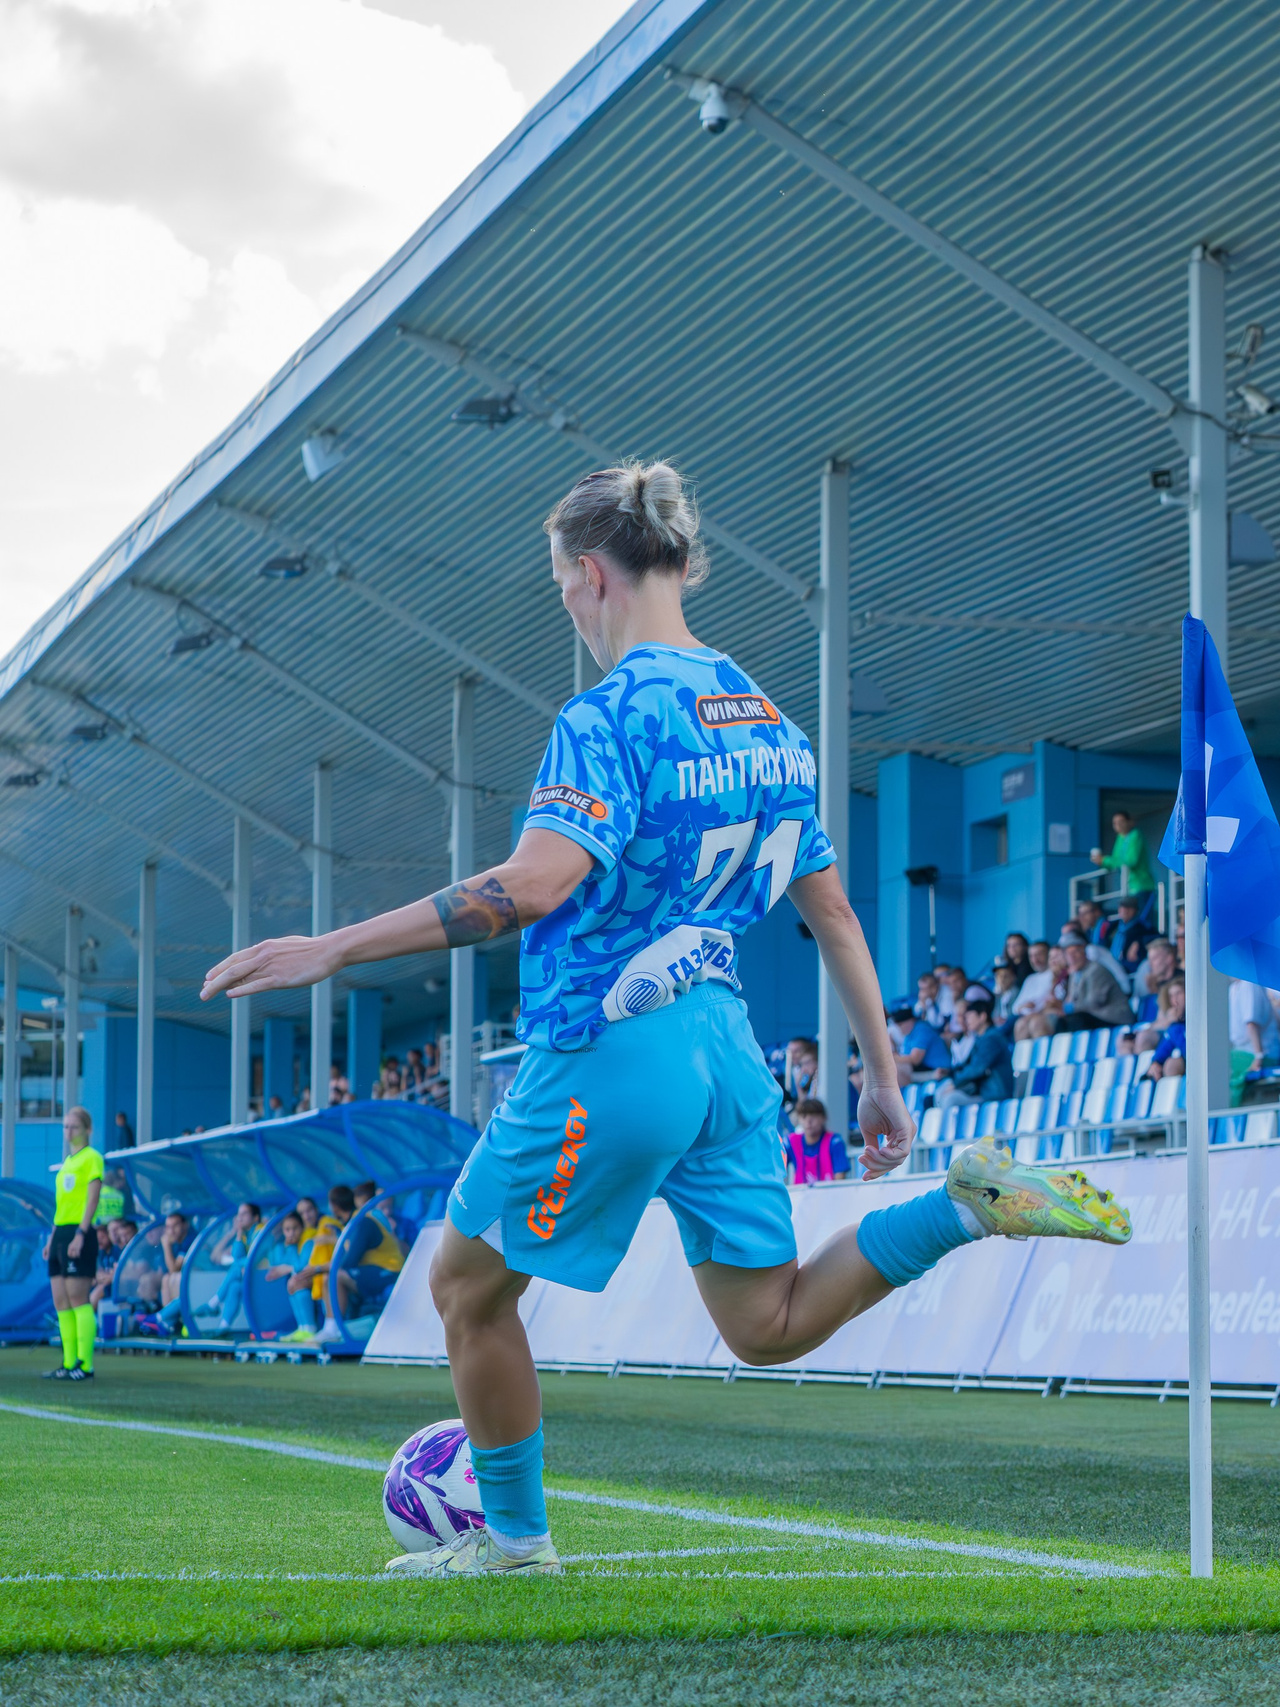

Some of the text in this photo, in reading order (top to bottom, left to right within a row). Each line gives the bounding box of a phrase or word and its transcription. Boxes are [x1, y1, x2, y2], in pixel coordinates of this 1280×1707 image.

[702, 699, 768, 722] WINLINE
[533, 788, 592, 810] WINLINE
[677, 746, 817, 800] ПАНТЮХИНА
[691, 818, 804, 914] 71
[1209, 1187, 1259, 1241] НА
